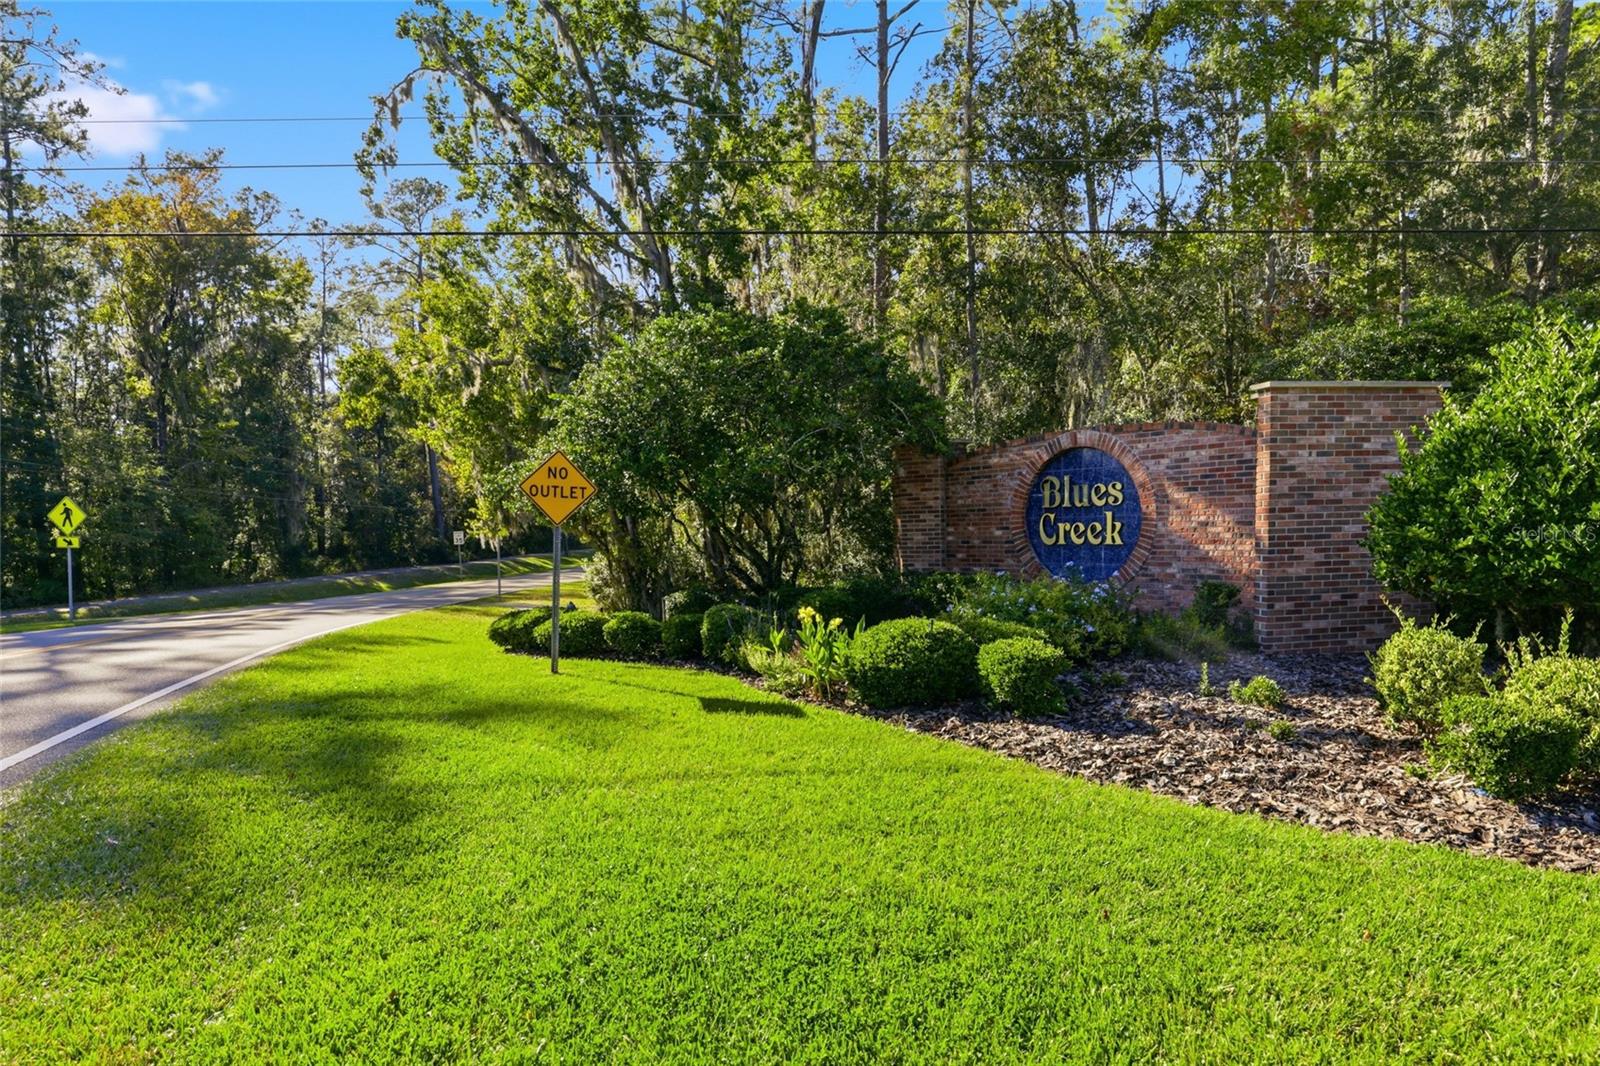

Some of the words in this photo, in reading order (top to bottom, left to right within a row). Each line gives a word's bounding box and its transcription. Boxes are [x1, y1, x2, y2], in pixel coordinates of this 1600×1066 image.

[548, 466, 568, 479] NO
[529, 484, 587, 499] OUTLET
[1040, 474, 1124, 508] Blues
[1039, 511, 1124, 545] Creek
